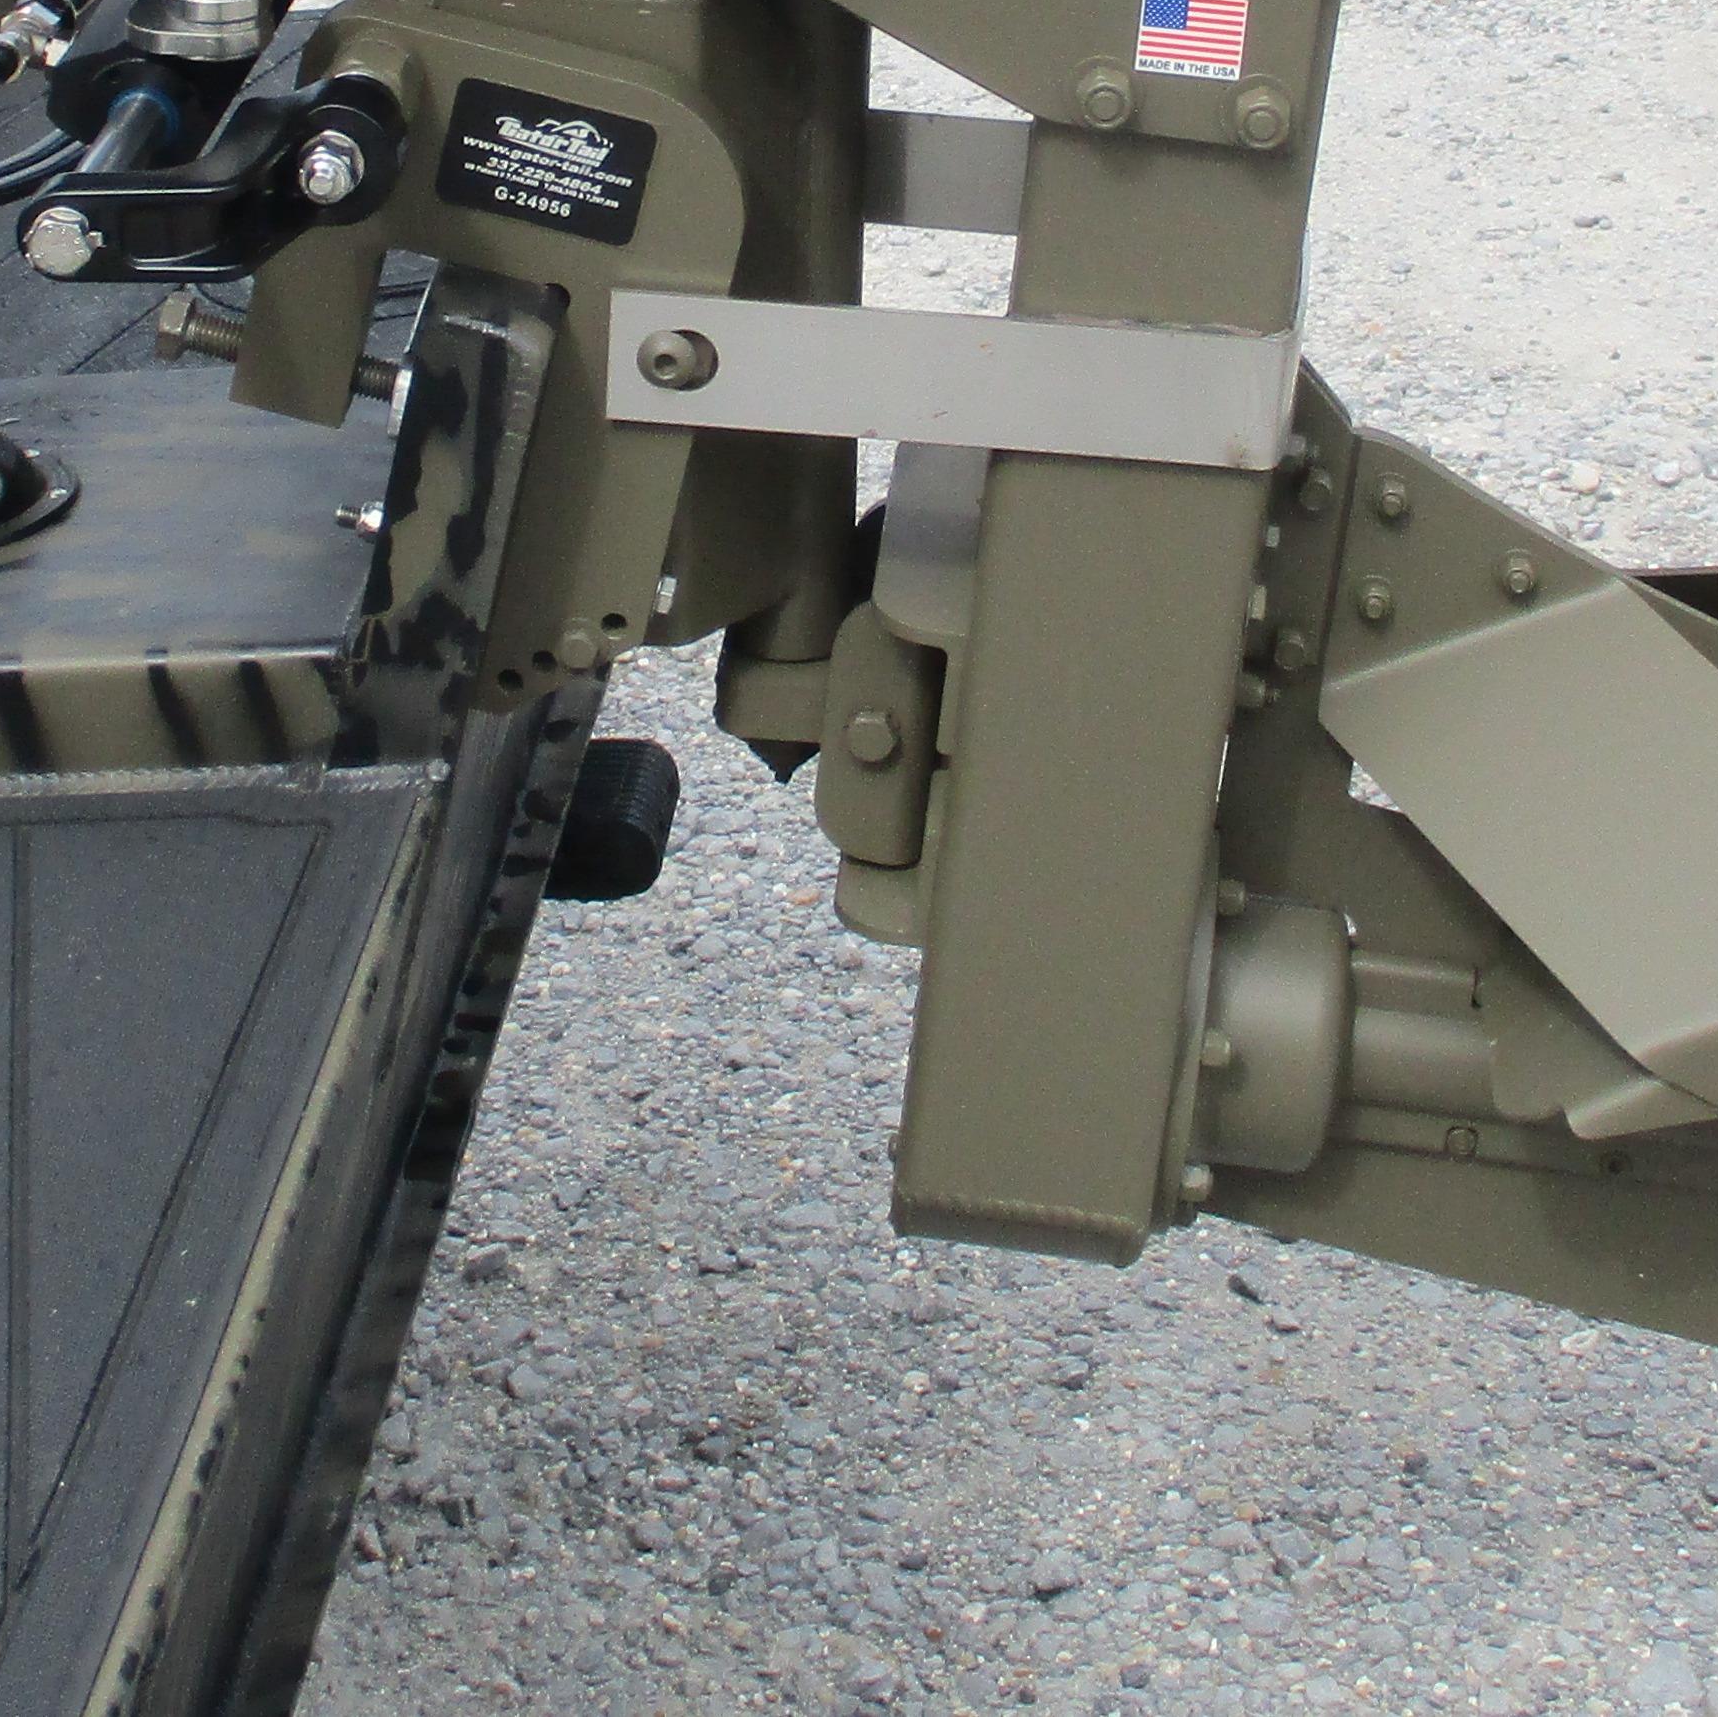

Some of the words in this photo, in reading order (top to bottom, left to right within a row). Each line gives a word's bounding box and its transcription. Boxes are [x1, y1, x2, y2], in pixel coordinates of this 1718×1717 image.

[1138, 58, 1172, 71] MADE
[1173, 62, 1186, 73] IN
[1188, 63, 1211, 76] THE
[1212, 65, 1236, 78] USA
[462, 135, 633, 188] www.gator-tail.com
[493, 185, 572, 219] G-24956
